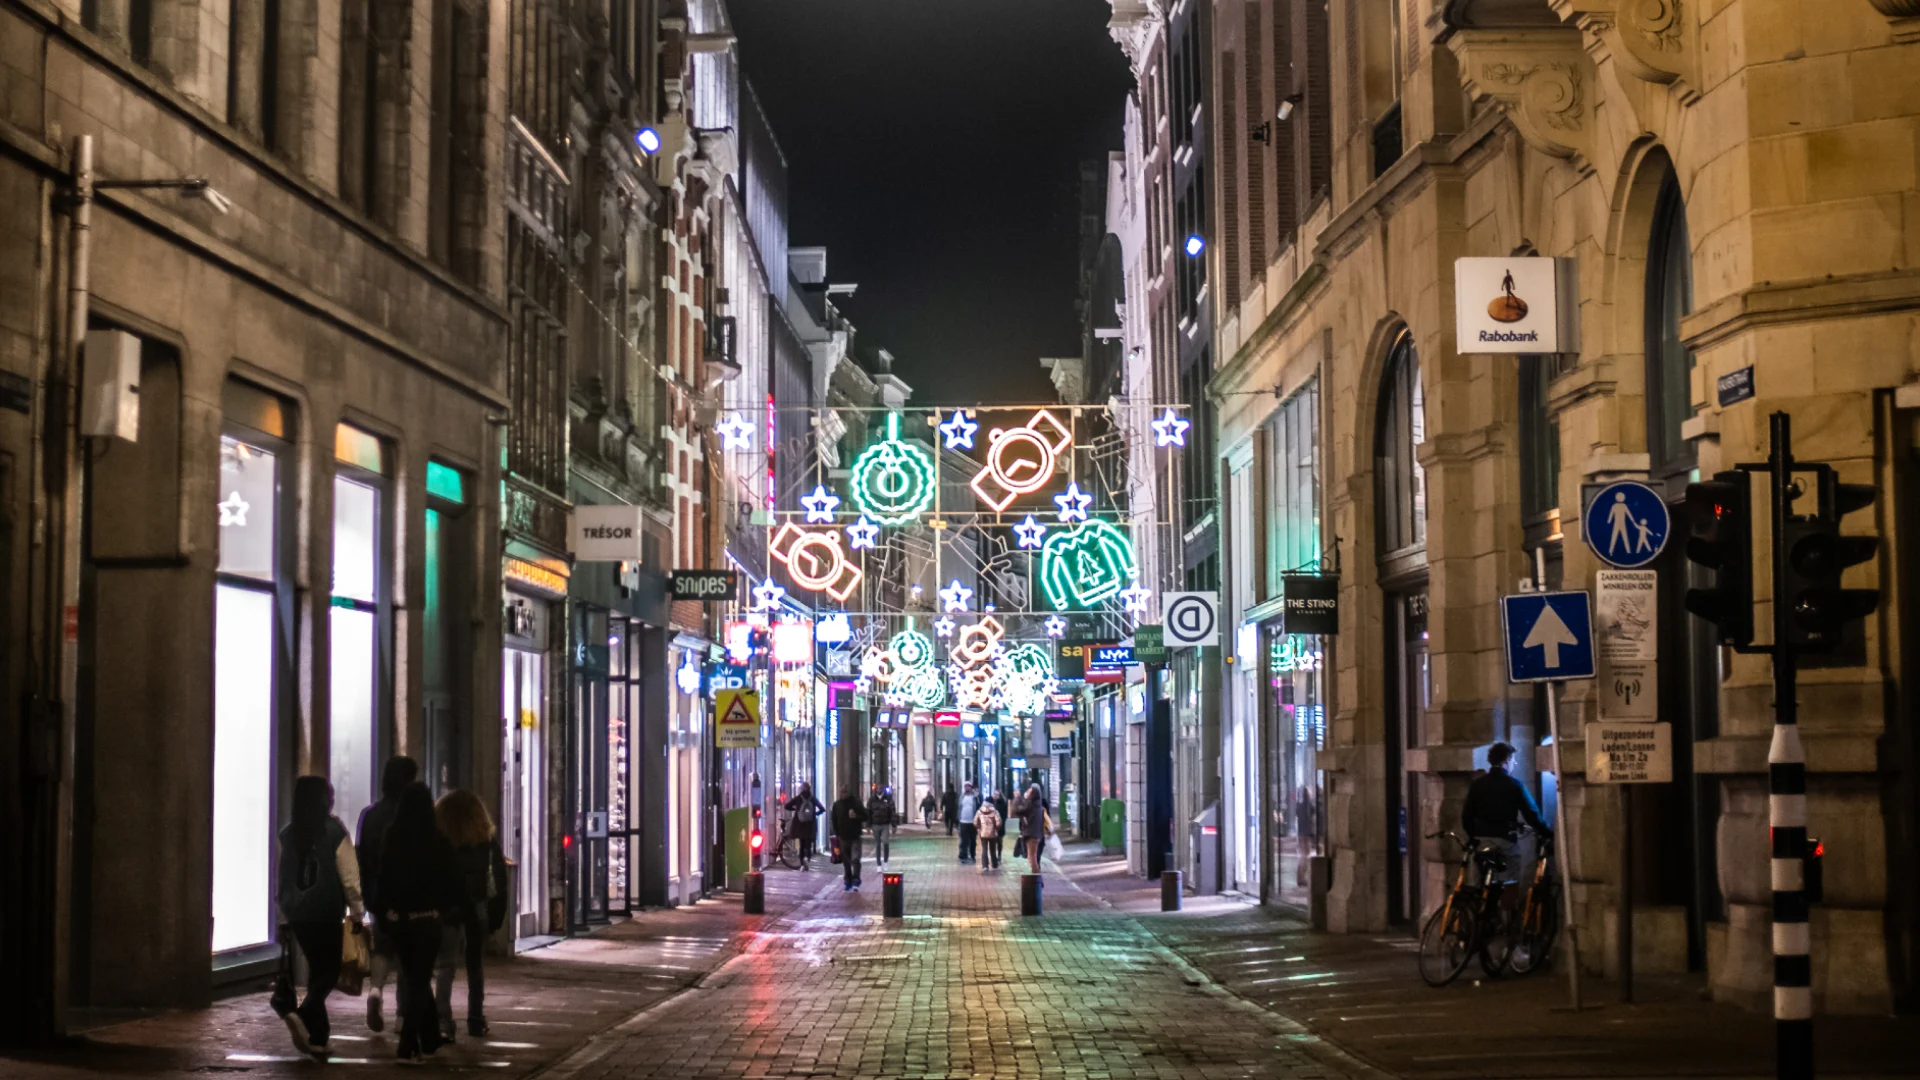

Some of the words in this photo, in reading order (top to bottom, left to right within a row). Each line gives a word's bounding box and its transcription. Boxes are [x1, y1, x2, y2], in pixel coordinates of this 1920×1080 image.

[1479, 330, 1538, 342] Rabobank
[583, 524, 632, 539] TRÉSOR
[675, 575, 727, 598] snipes
[1286, 598, 1305, 609] THE
[1307, 598, 1336, 608] STING
[1135, 632, 1163, 641] HOLLAN
[1061, 645, 1084, 657] sa
[1099, 649, 1130, 661] NYX
[1602, 729, 1655, 741] Uitgezonderd
[1601, 742, 1656, 752] Laden/Lossen
[1609, 752, 1621, 762] Ma
[1638, 752, 1648, 762] Za
